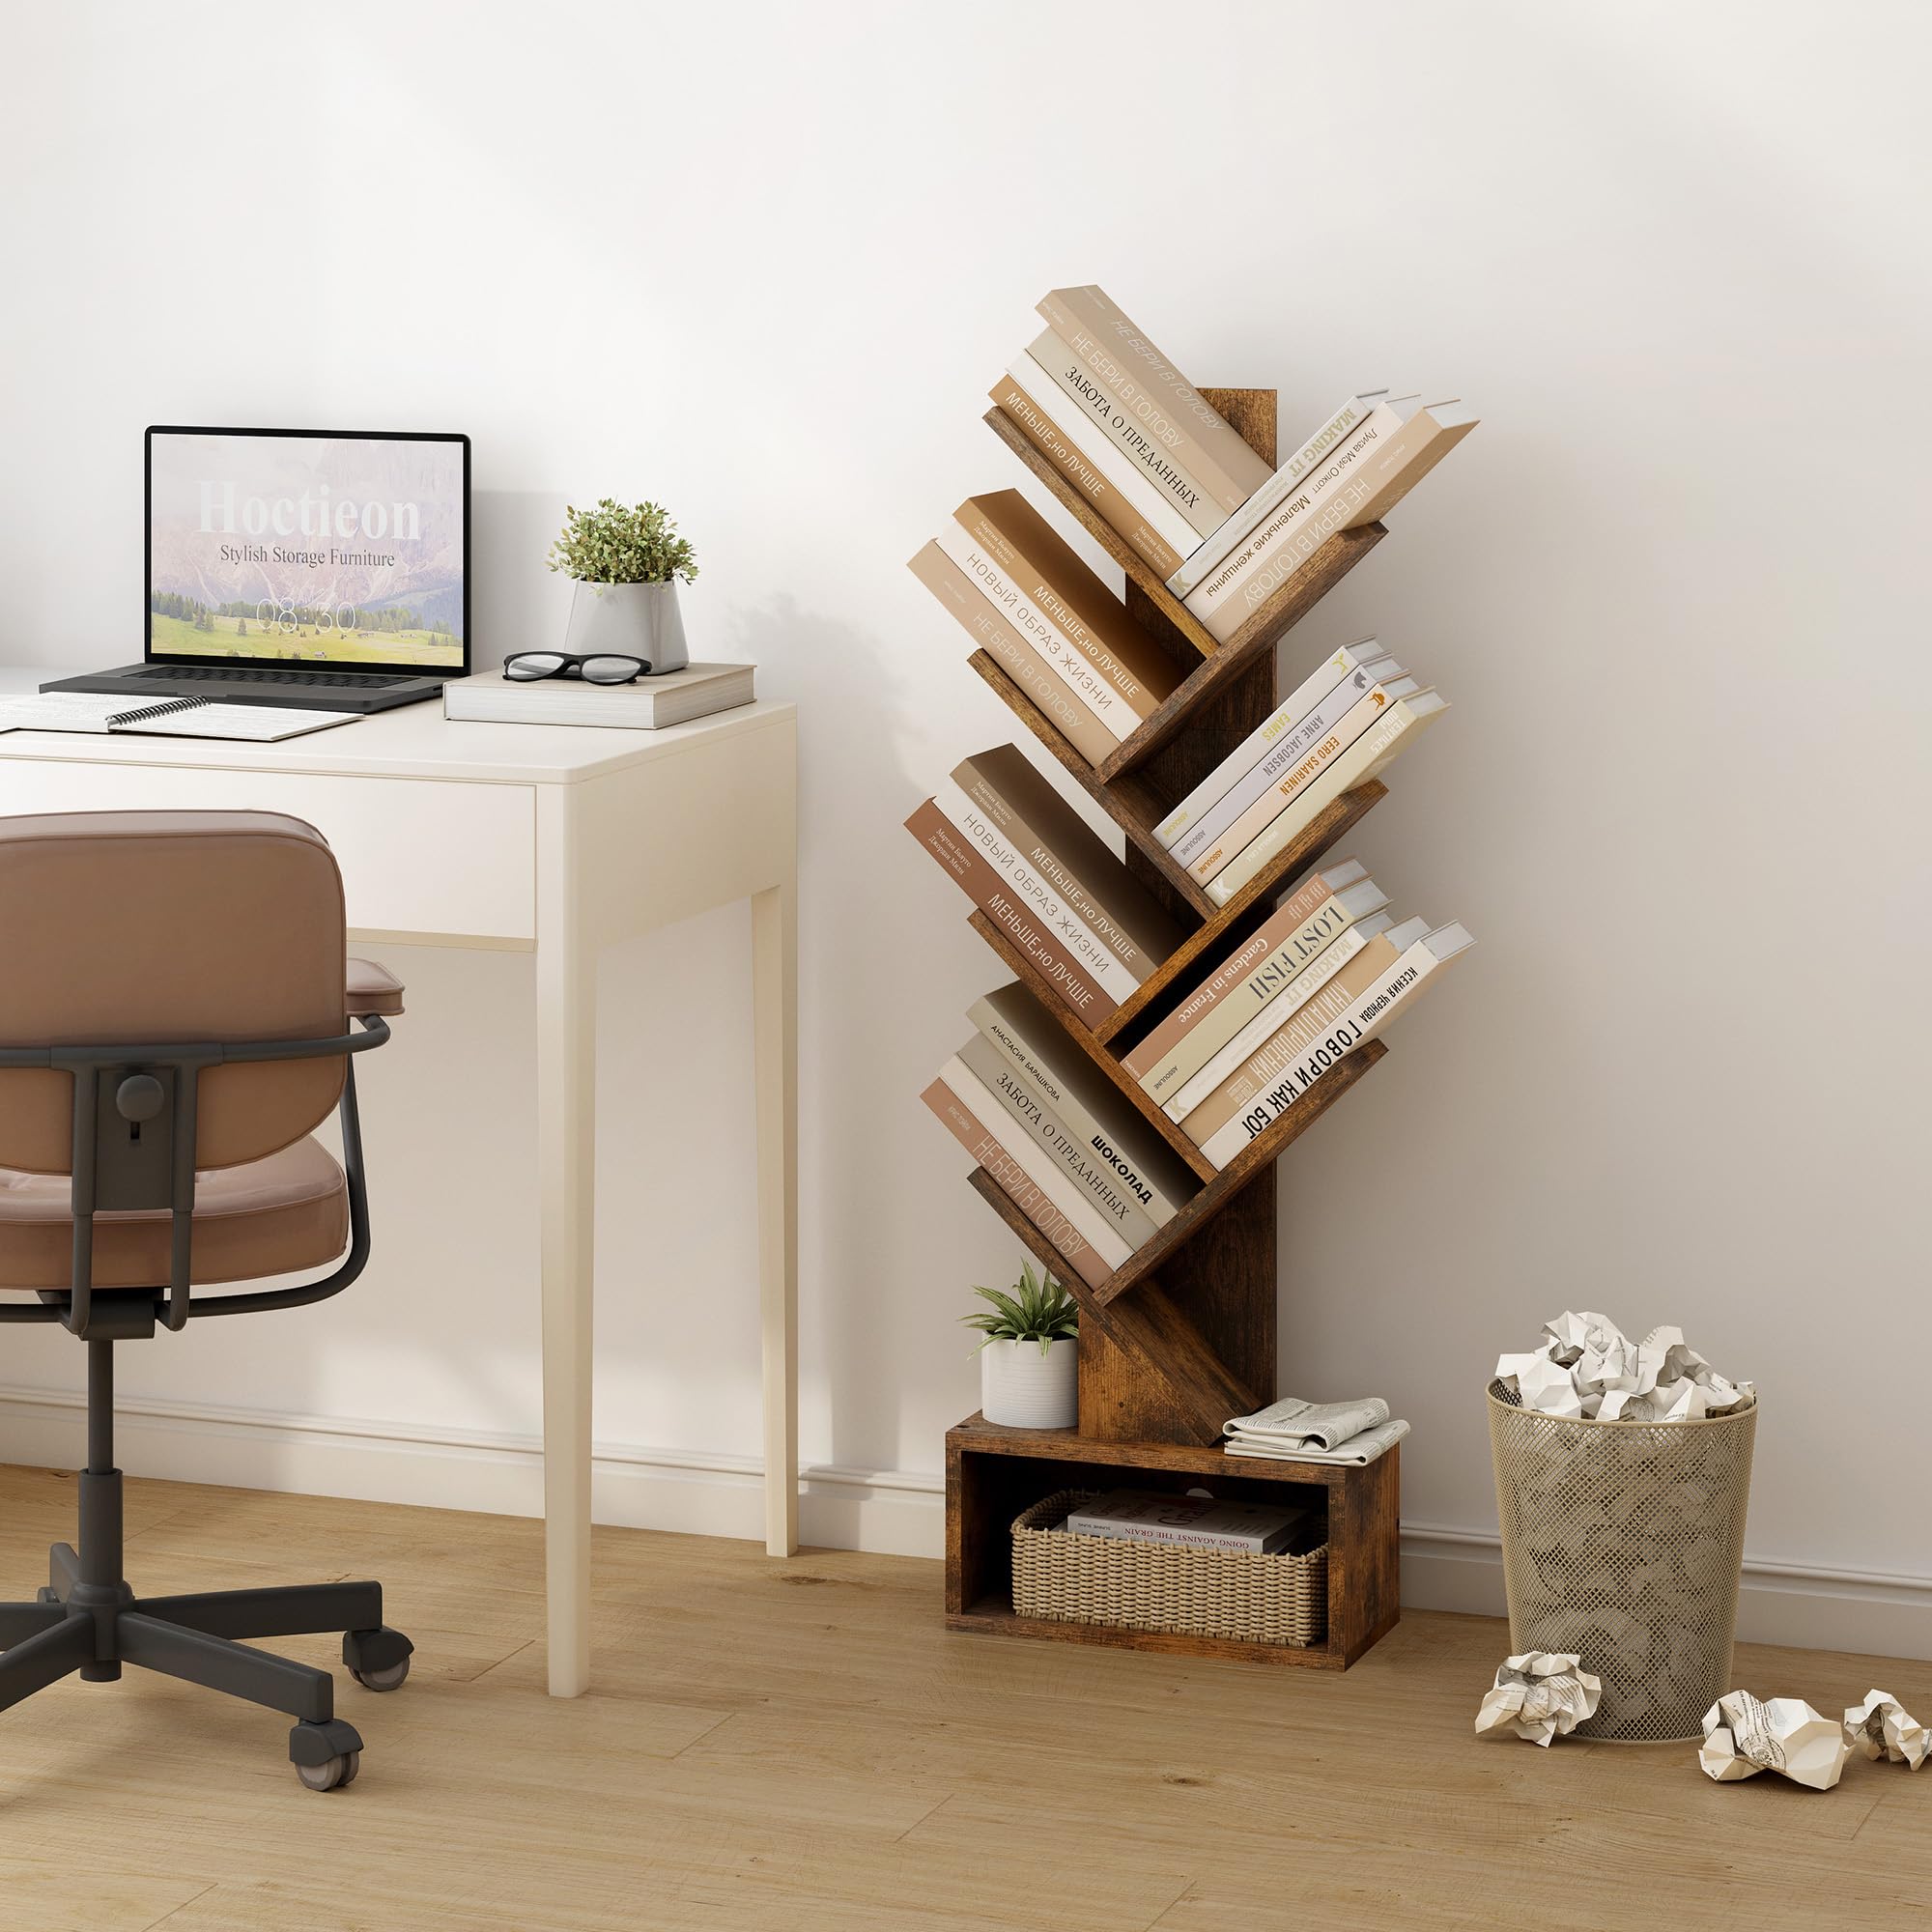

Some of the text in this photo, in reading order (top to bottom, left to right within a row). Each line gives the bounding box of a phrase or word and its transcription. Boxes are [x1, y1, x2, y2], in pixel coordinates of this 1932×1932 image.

[1068, 330, 1094, 356] НЕ
[1086, 349, 1125, 390] БЕРИ
[1119, 383, 1136, 401] В
[1128, 393, 1184, 452] ГОЛОВУ
[1109, 320, 1224, 432] НЕ БЕРИ В ГОЛОВУ
[1063, 365, 1114, 418] ЗАБОТА
[1108, 413, 1126, 432] О
[1120, 425, 1201, 509] ПРЕДАННЫХ
[1301, 407, 1356, 464] MAKING
[1334, 447, 1356, 469] Мэй
[1350, 427, 1378, 454] Луиза
[1062, 452, 1105, 497] ЛУЧШЕ
[1287, 458, 1305, 477] IT
[1308, 463, 1339, 495] Олкотт
[1345, 476, 1371, 505] НЕ
[193, 479, 421, 541] Hoctieon
[978, 519, 1000, 543] Мартин
[1251, 493, 1311, 553] Маленькие
[1306, 496, 1351, 542] БЕРИ
[220, 545, 394, 567] Stylish Storage Furniture
[993, 546, 1011, 565] Мили
[1130, 530, 1168, 570] Джордан Мили
[1136, 525, 1157, 548] Мартин
[1293, 531, 1313, 554] В
[1203, 546, 1256, 599] женщины
[1236, 543, 1301, 609] ГОЛОВУ
[256, 597, 355, 634] 08:30
[965, 552, 1113, 710] НОВЫЙ ОБРАЗ ЖИЗНИ
[971, 611, 1084, 731] НЕ БЕРИ В ГОЛОВУ
[1094, 650, 1139, 698] ЛУЧШЕ
[1261, 711, 1292, 742] EAMES
[1261, 713, 1325, 777] ARNE JACOBSEN
[1369, 717, 1406, 754] TEXTILES
[1278, 734, 1341, 796] EERO SAARINEN
[968, 785, 1008, 827] Джордан Мили
[974, 780, 997, 804] Мартин
[926, 834, 965, 876] Джордан Мили
[934, 827, 956, 851] Мартин
[1179, 829, 1207, 856] ASSOULINE
[1196, 847, 1224, 875] ASSOULINE
[962, 812, 1110, 973] НОВЫЙ ОБРАЗ ЖИЗНИ
[1092, 915, 1137, 962] ЛУЧШЕ
[1246, 904, 1346, 1001] LOST FISH
[1047, 959, 1094, 1009] ЛУЧШЕ
[1176, 935, 1270, 1026] Gardens in France
[1282, 937, 1353, 1007] MAKING IT
[1357, 965, 1418, 1025] КСЕНИЯ ЧЕРНОВА
[989, 1023, 1062, 1101] АНАСТАСИЯ БАРАШКОВА
[1293, 1018, 1363, 1088] ГОВОРИ
[1151, 1064, 1179, 1091] ASSOULINE
[1264, 1078, 1300, 1114] КАК
[1238, 1104, 1272, 1140] БОГ
[995, 1072, 1130, 1220] ЗАБОТА О ПРЕДАННЫХ
[1090, 1134, 1154, 1205] ШОКОЛАД
[971, 1134, 1088, 1262] НЕ БЕРИ В ГОЛОВУ
[1123, 1527, 1249, 1549] GOING AGAINST THE GRAIN
